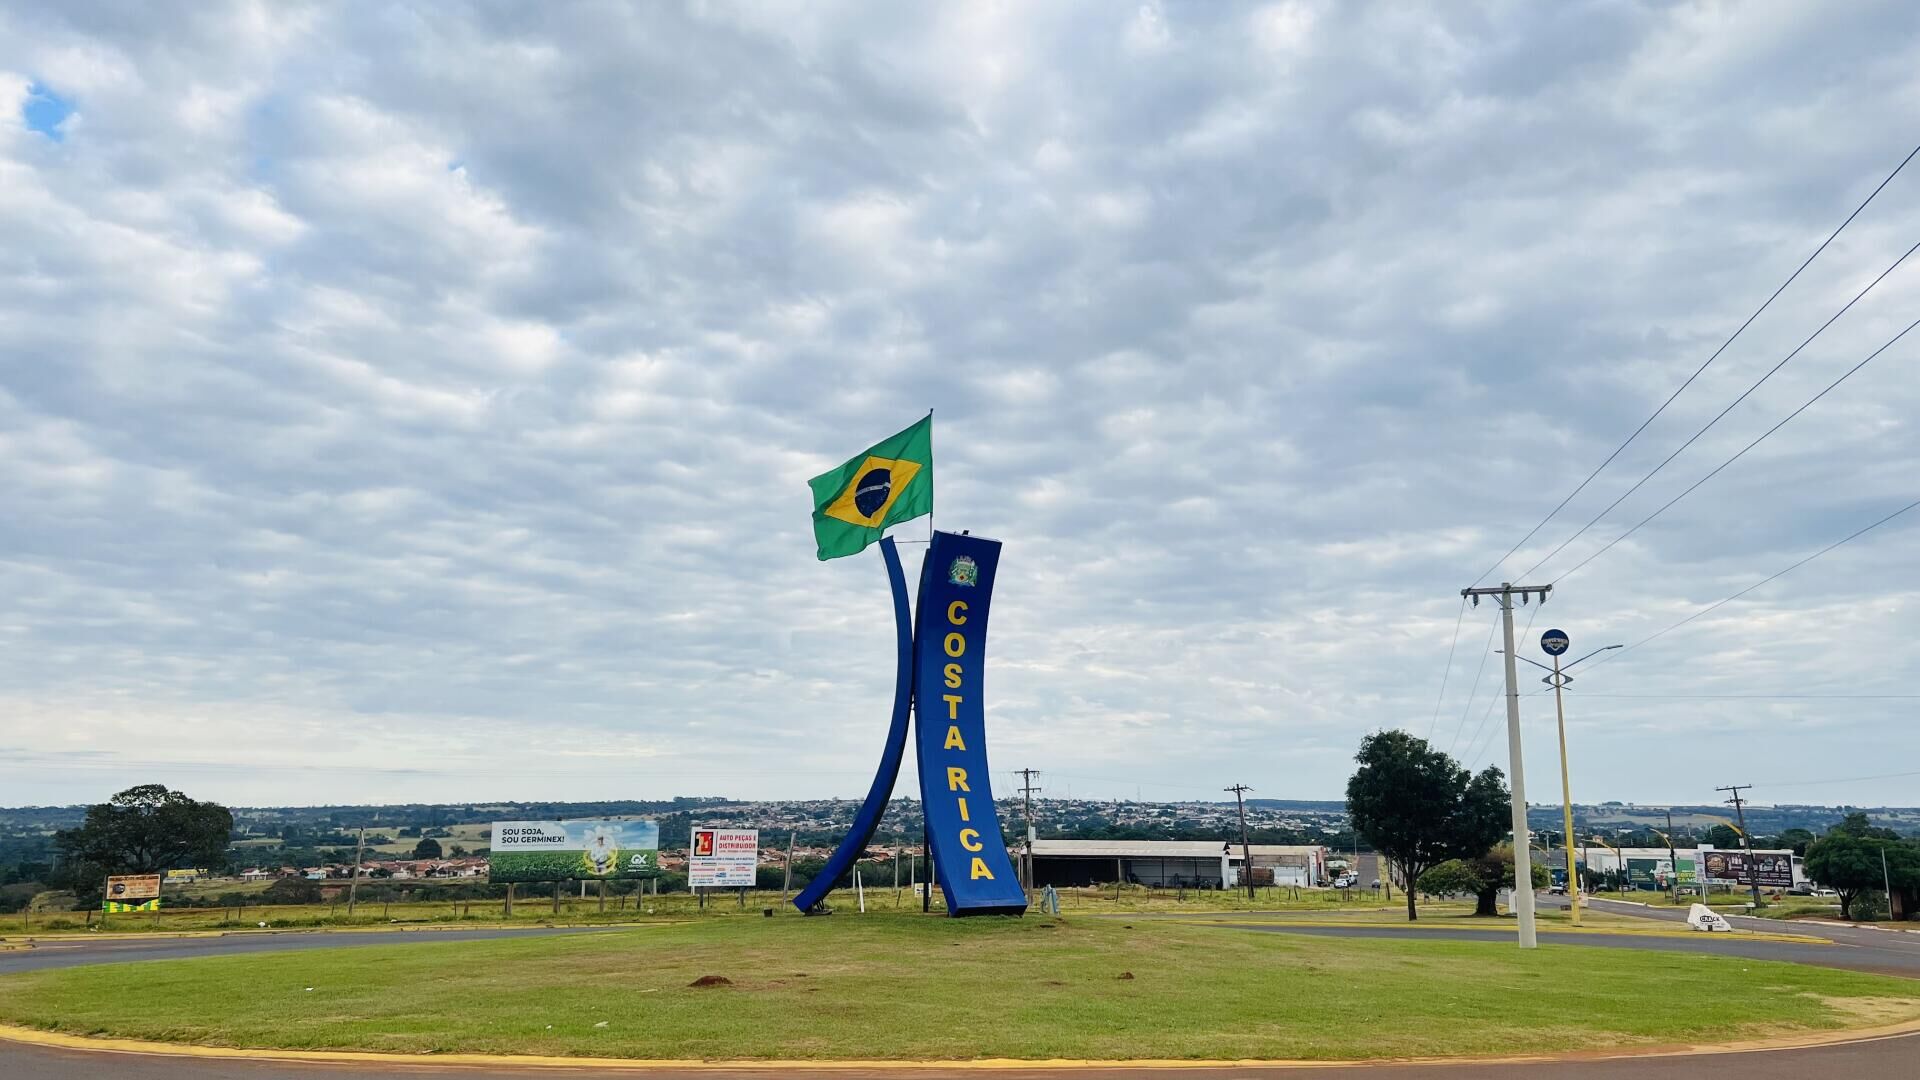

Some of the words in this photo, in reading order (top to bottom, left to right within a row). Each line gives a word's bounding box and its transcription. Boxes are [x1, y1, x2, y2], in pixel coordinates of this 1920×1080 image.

[943, 600, 968, 751] COSTA
[501, 836, 519, 844] SOU
[502, 828, 519, 836] SOU
[521, 828, 545, 836] SOJA,
[947, 766, 995, 880] RICA
